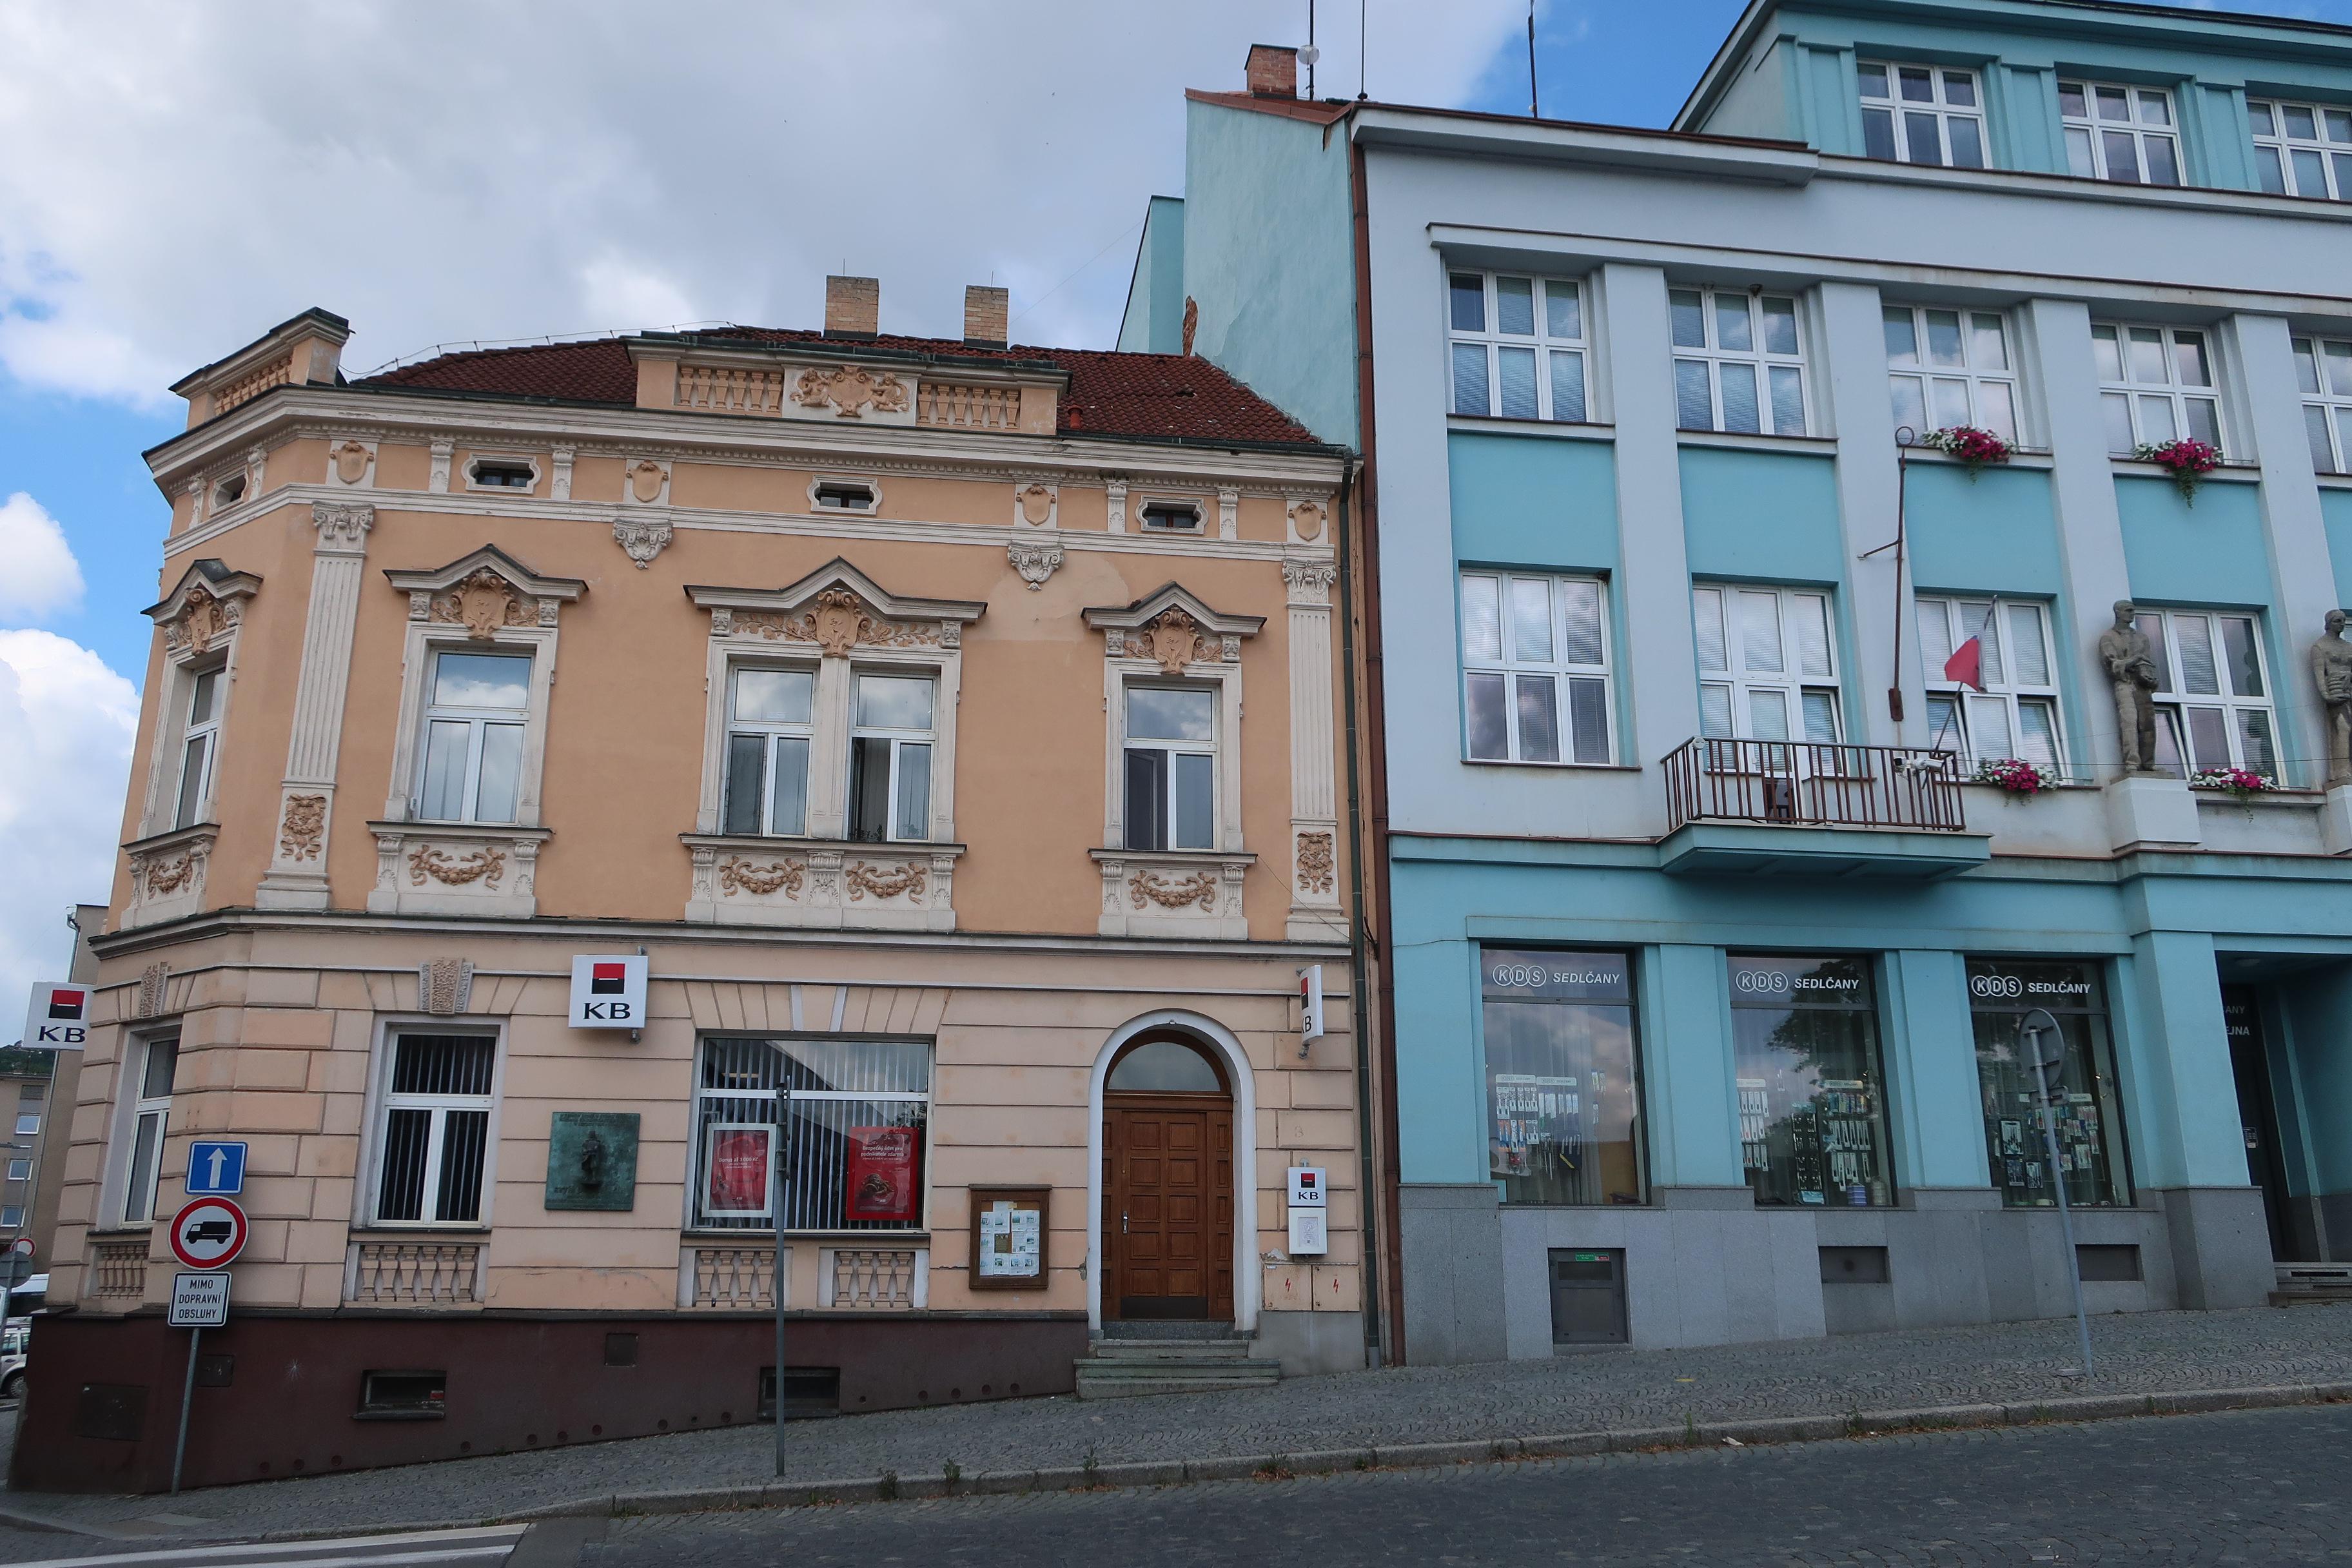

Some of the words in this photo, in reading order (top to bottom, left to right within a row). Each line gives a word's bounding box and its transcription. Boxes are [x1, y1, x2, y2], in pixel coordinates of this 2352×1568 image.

[1496, 968, 1542, 984] KDS
[1553, 971, 1620, 984] SEDLČANY
[1740, 974, 1784, 989] KDS
[1794, 977, 1859, 989] SEDLČANY
[1975, 979, 2019, 994] KDS
[2027, 981, 2092, 994] SEDLČANY
[582, 1002, 631, 1019] KB
[37, 1026, 86, 1043] KB
[1298, 1191, 1319, 1200] KB
[190, 1279, 213, 1289] MIMO
[179, 1291, 222, 1304] DOPRAVNÍ
[179, 1309, 217, 1318] OBSLUHY
